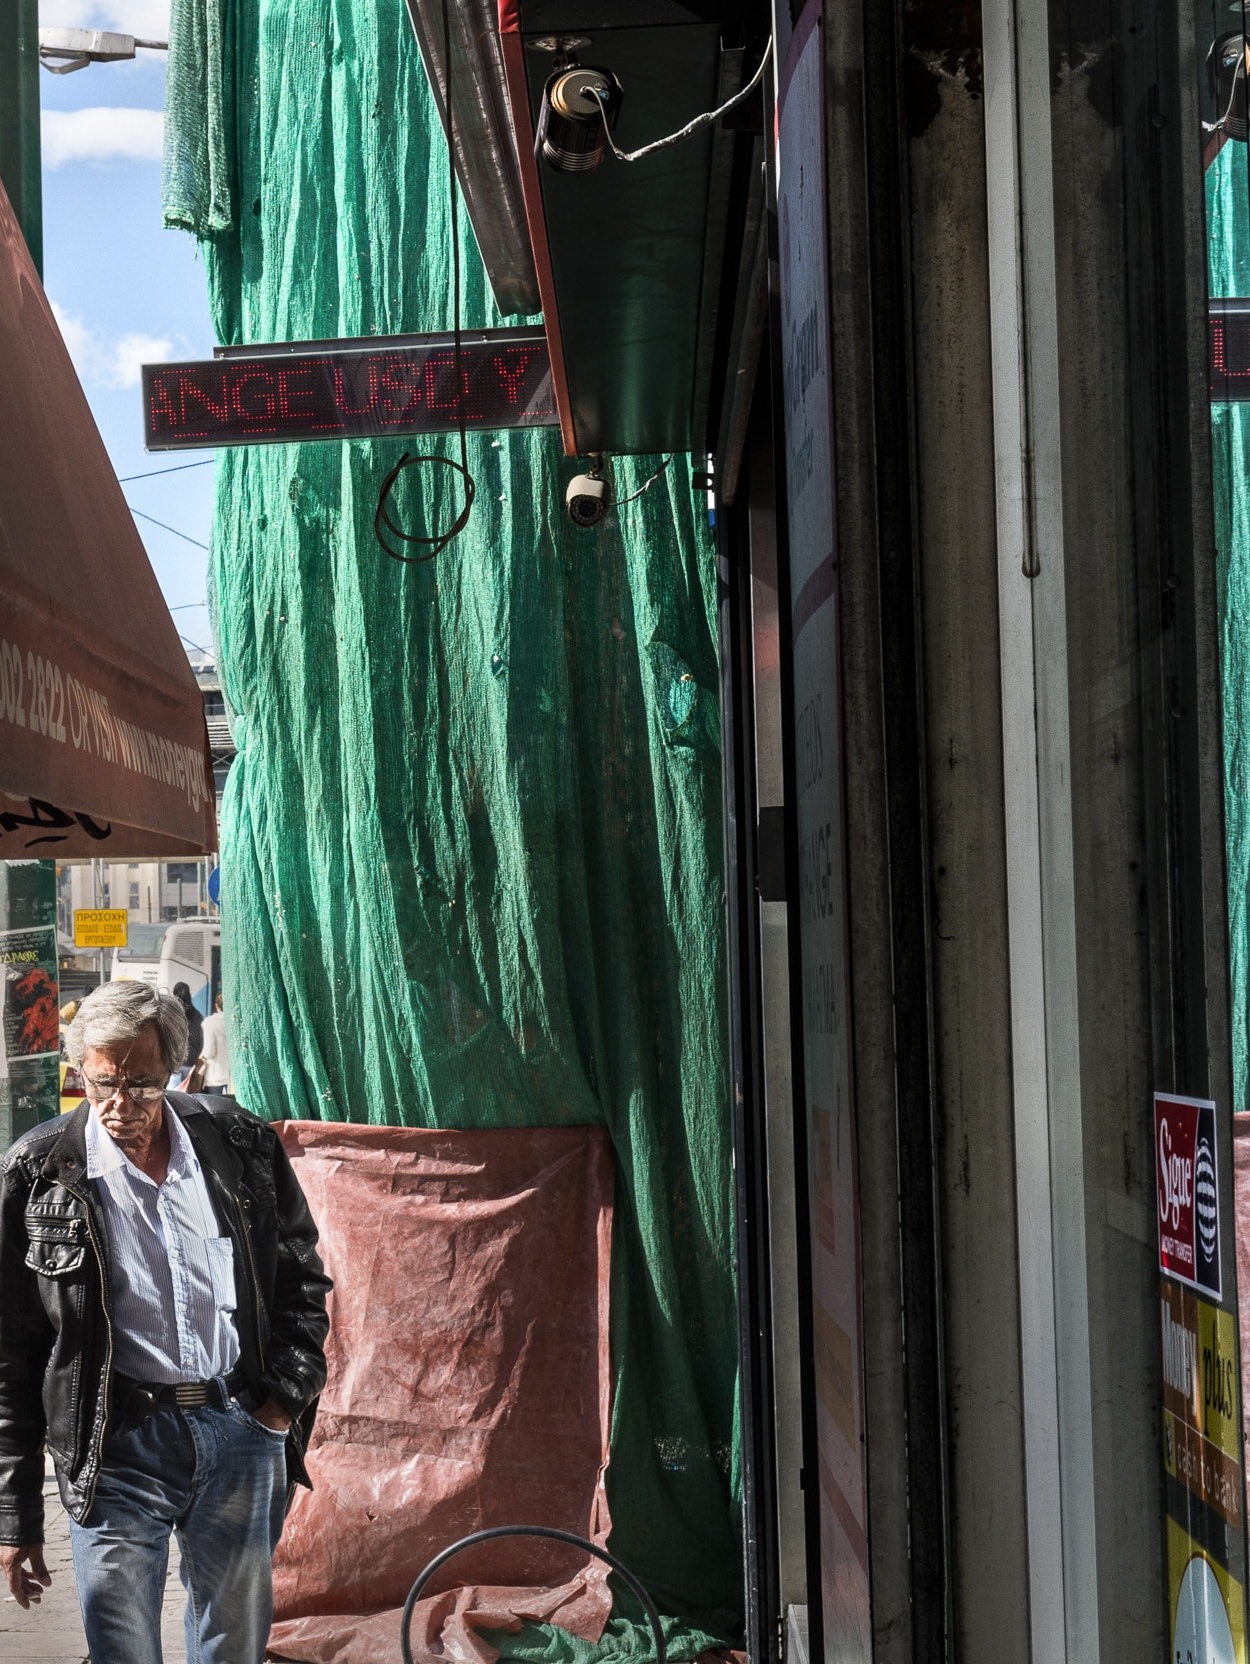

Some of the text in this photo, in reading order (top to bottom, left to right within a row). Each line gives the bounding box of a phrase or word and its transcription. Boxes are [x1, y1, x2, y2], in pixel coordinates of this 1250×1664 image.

[27, 650, 67, 743] 2822
[76, 912, 125, 922] ΠΡΟΣΟΧΗ
[77, 924, 99, 933] ΕΙΣΟΔΟΣ
[1160, 1117, 1193, 1231] Sigue
[1161, 1298, 1234, 1437] Money plus
